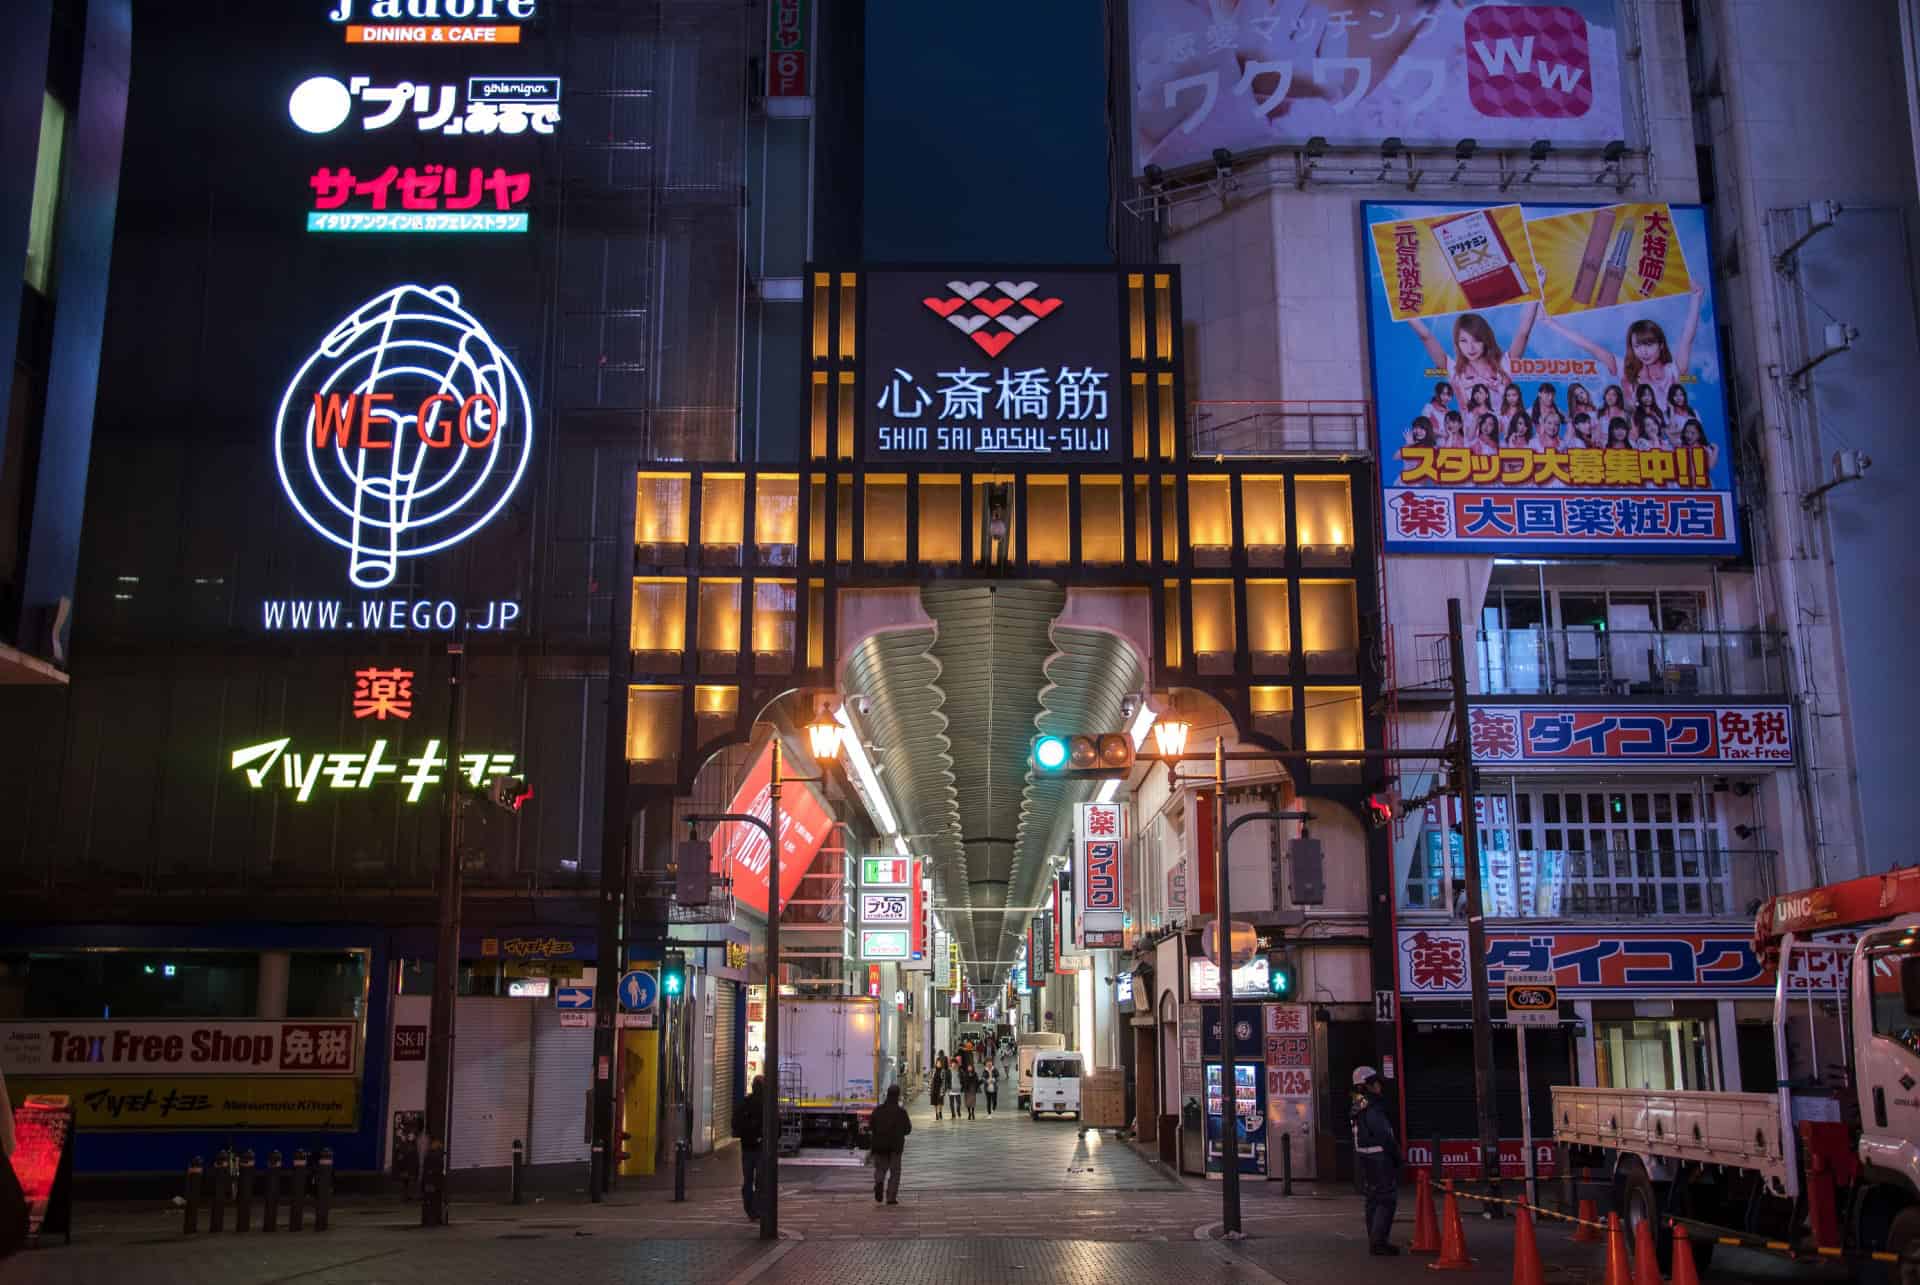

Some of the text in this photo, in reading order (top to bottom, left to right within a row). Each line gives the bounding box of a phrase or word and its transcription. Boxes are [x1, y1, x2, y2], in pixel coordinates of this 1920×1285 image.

[363, 27, 497, 41] DINING & CAFE
[1163, 57, 1446, 134] ワクワク
[310, 165, 531, 210] サイゼリヤ
[877, 367, 1109, 420] 心斎橋筋
[879, 428, 927, 450] SHIN
[938, 428, 971, 450] SAI
[1397, 496, 1717, 537] 薬 大国薬粧店
[353, 667, 414, 720] 薬
[1470, 708, 1788, 758] 薬 ダイコク 免税
[1090, 806, 1115, 835] 薬
[1090, 844, 1117, 905] ダイコク
[1777, 897, 1812, 921] UNIC
[1411, 931, 1467, 989] 薬
[50, 1030, 274, 1064] Tax Free Shop
[284, 1029, 348, 1065] 免税
